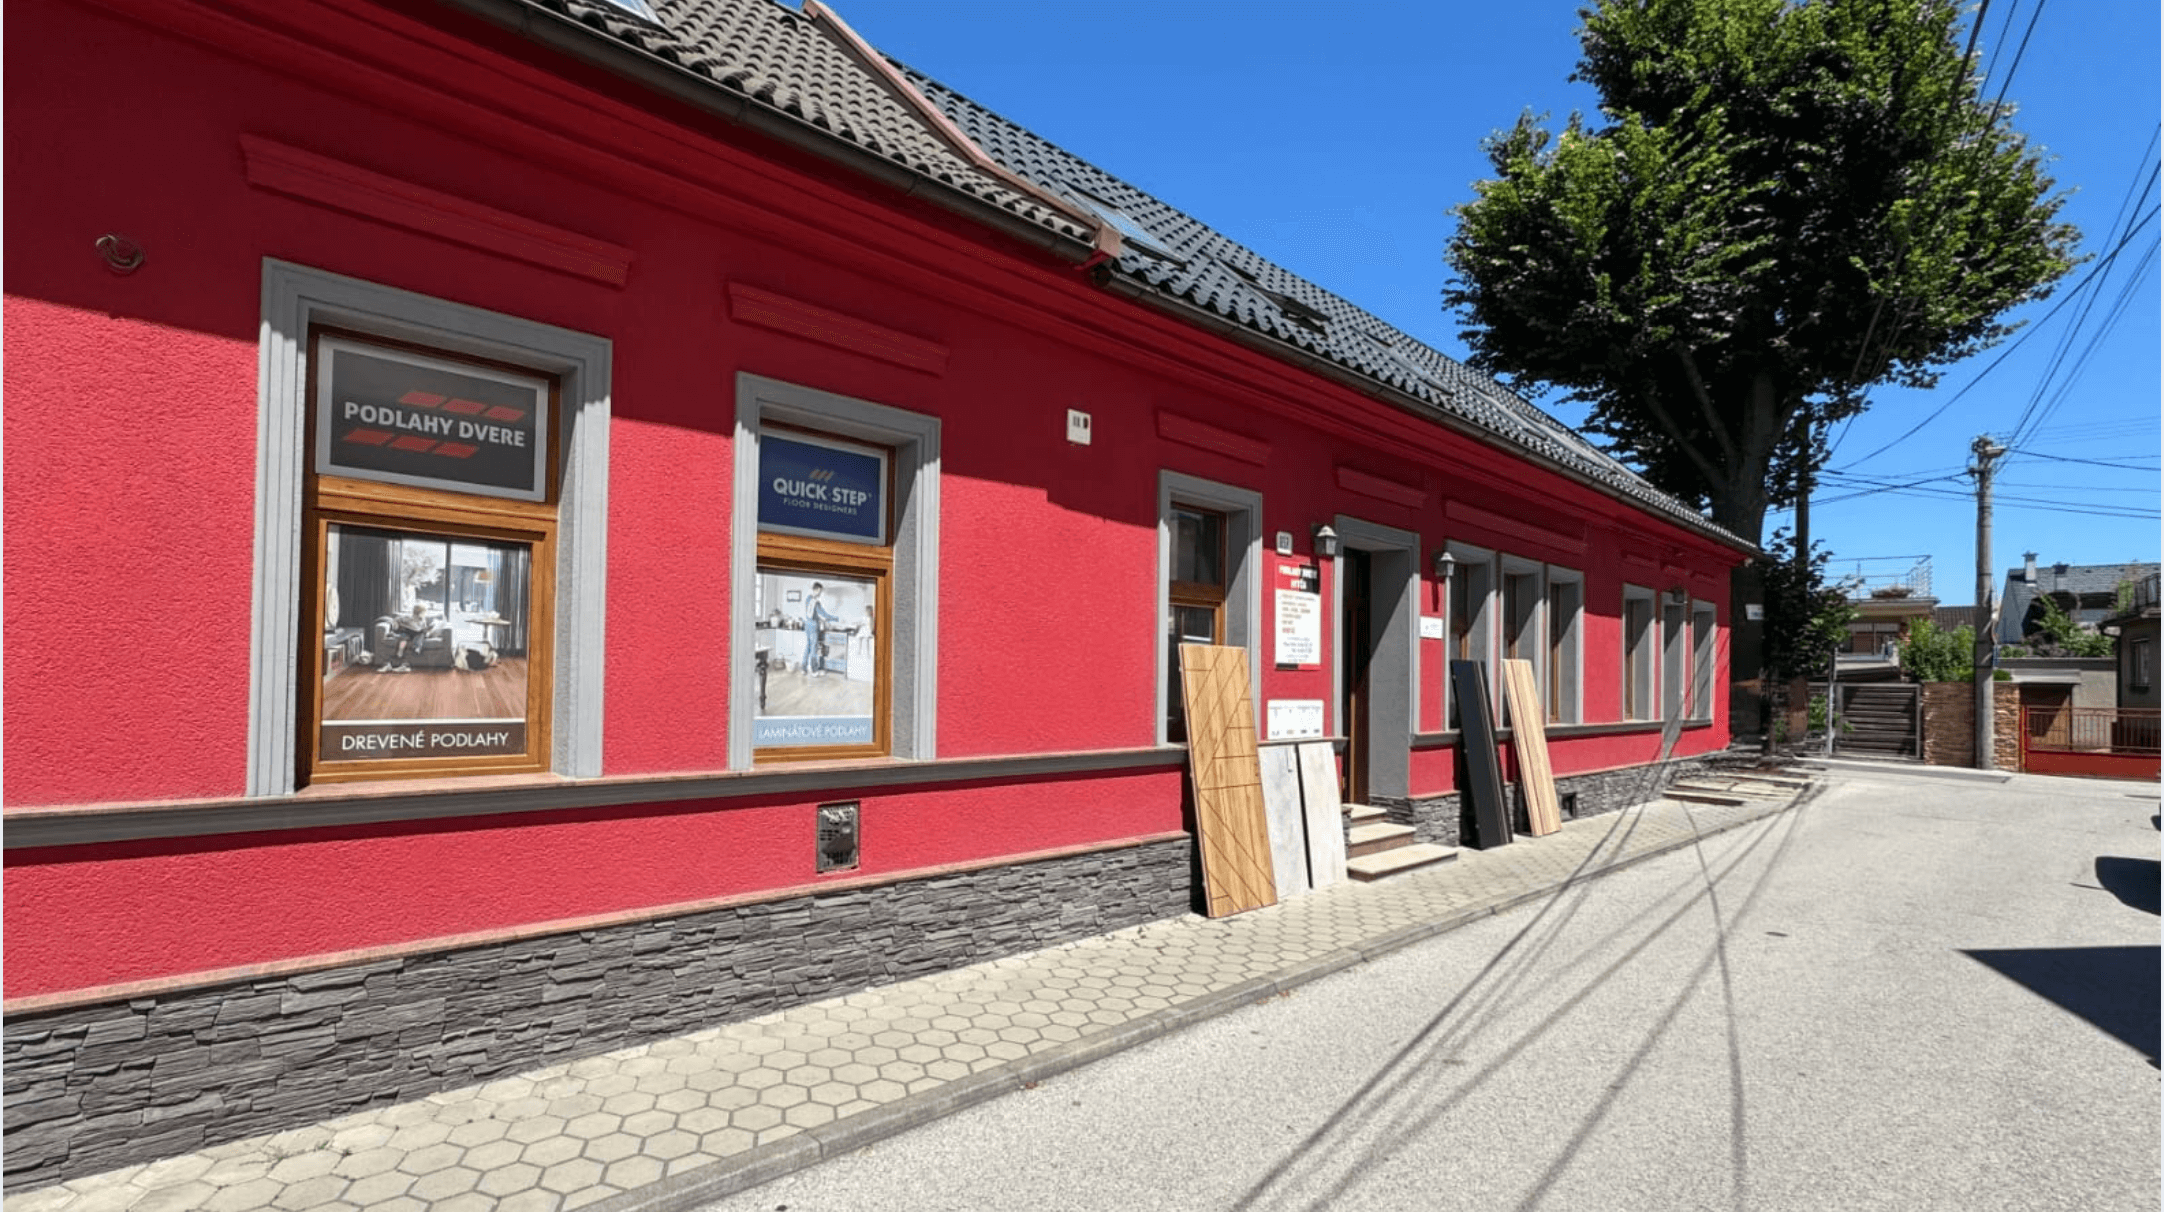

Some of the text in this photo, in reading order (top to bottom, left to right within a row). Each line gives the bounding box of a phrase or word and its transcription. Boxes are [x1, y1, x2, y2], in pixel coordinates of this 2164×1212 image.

[344, 401, 525, 447] PODLAHY DVERE
[773, 478, 867, 506] QUICK STEP
[342, 730, 509, 750] DREVENÉ PODLAHY
